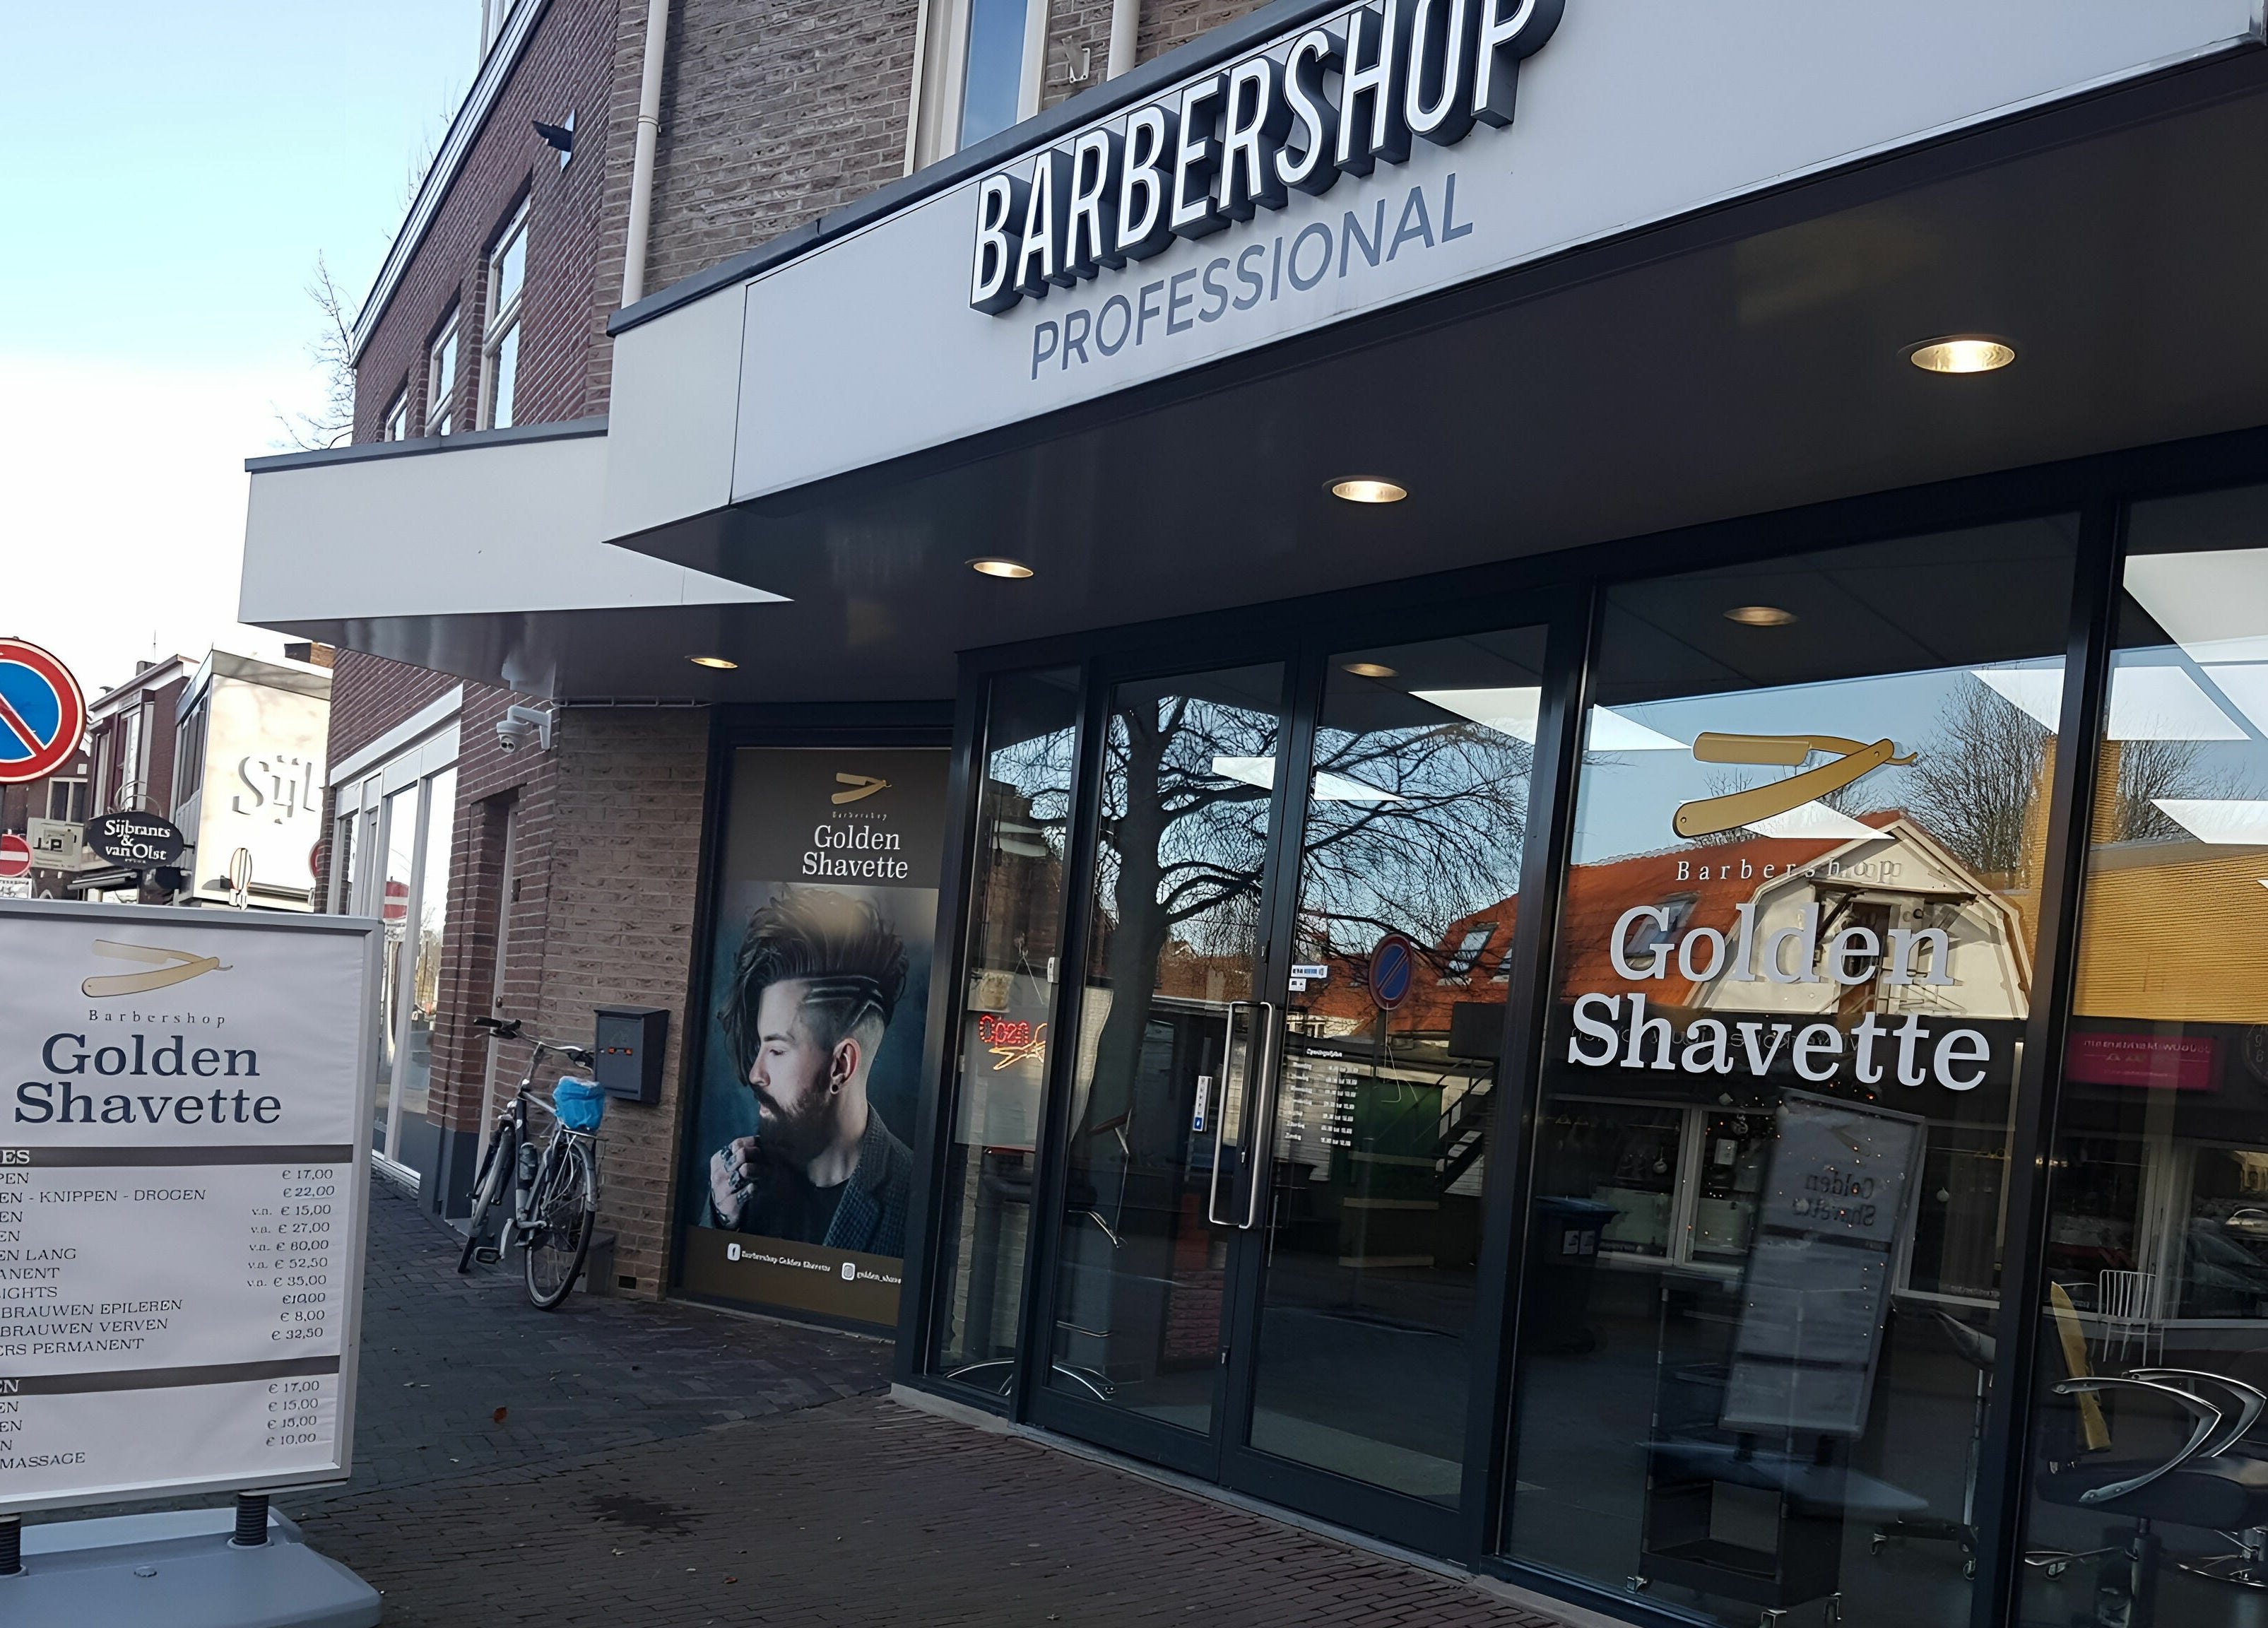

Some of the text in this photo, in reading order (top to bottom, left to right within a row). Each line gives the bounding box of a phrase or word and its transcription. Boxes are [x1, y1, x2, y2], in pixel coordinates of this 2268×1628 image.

[971, 0, 1544, 307] BARBERSHOP
[1031, 174, 1473, 380] PROFESSIONAL
[104, 819, 171, 838] Sijbrants
[813, 824, 901, 851] Golden
[120, 834, 134, 847] &
[105, 844, 167, 860] van Olst
[801, 851, 909, 880] Shavette
[1675, 858, 1896, 884] Barbershop
[1610, 902, 1954, 986] Golden
[89, 1009, 225, 1028] Barbershop
[1567, 991, 1990, 1092] Shavette
[42, 1032, 261, 1077] Golden
[14, 1081, 282, 1125] Shavette
[40, 1190, 117, 1202] KNIPPEN
[134, 1188, 206, 1201] DROGEN
[26, 1248, 76, 1260] LANG
[0, 1286, 57, 1299] IGHTS
[1, 1299, 183, 1318] BRAUWEN EPILEREN
[0, 1317, 168, 1336] BRAUWEN VERVEN
[33, 1338, 144, 1354] PERMANENT
[0, 1452, 85, 1468] MASSAGE
